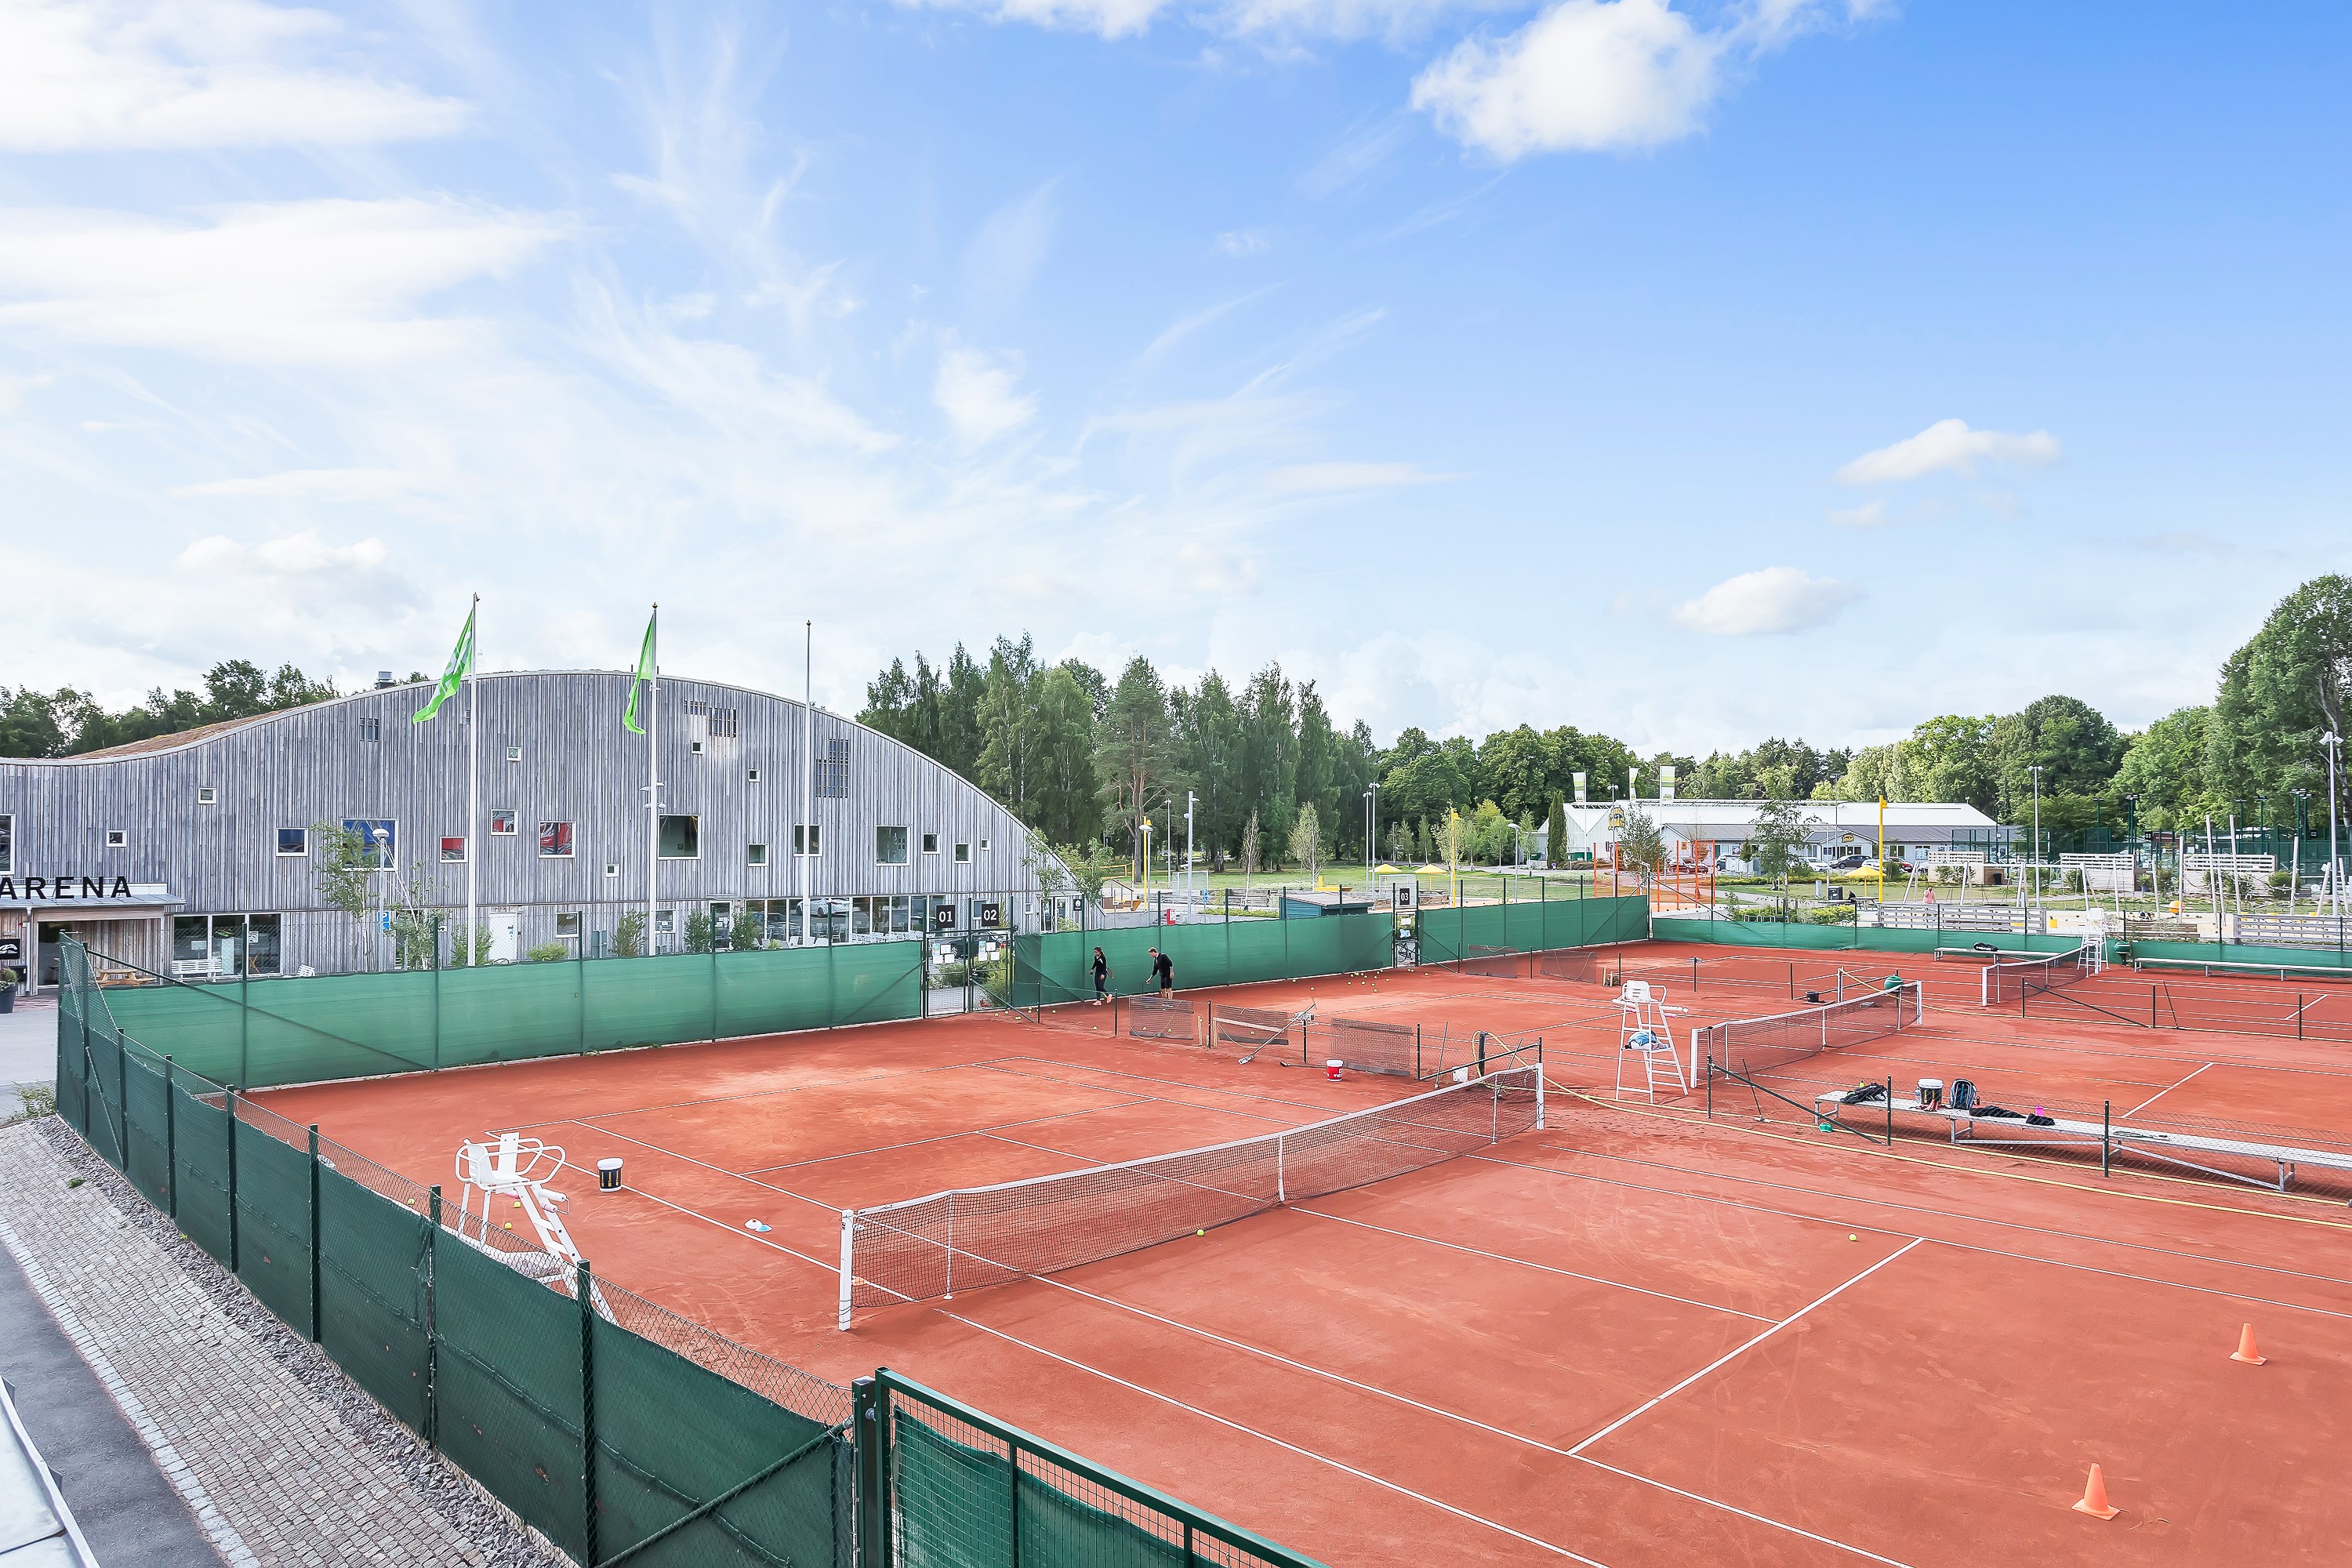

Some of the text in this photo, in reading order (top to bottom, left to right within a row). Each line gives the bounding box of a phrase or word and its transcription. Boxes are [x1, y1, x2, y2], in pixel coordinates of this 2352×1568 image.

[0, 876, 132, 899] ARENA
[1400, 893, 1409, 902] 03
[938, 911, 953, 922] 01
[983, 909, 997, 921] 02
